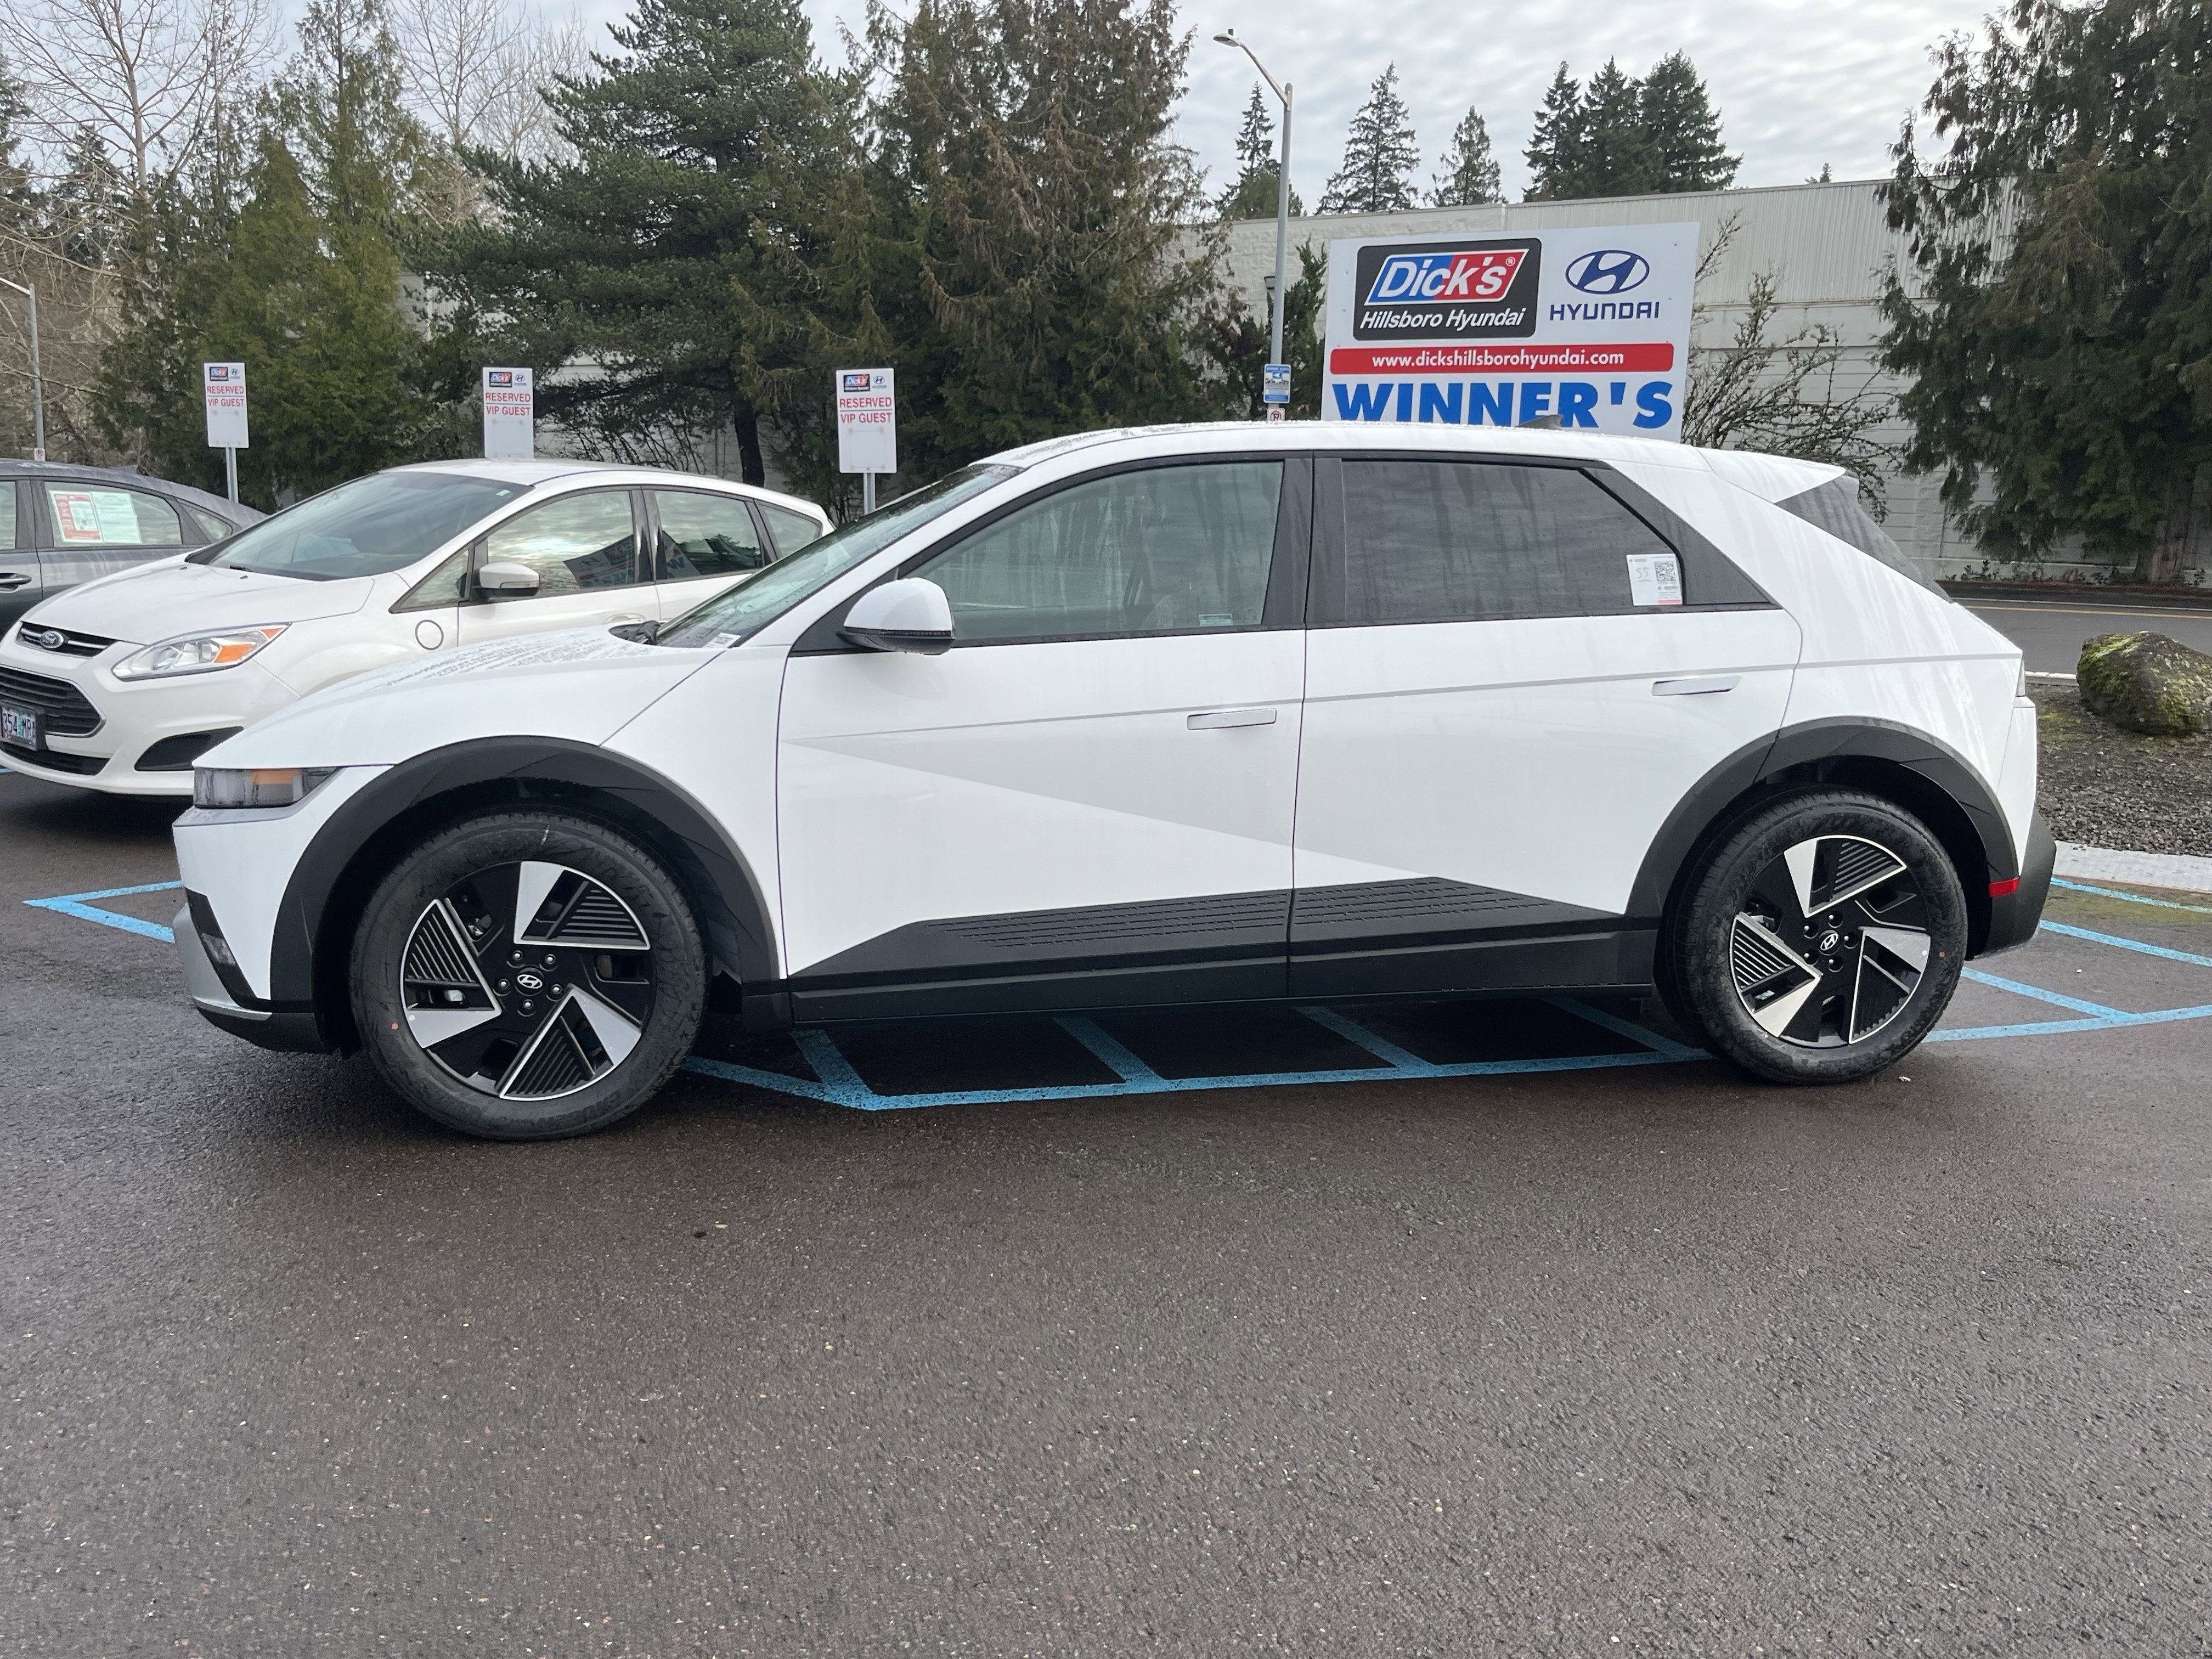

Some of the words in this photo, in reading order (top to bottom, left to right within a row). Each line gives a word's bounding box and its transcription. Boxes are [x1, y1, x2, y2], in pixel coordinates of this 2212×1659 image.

[1378, 257, 1507, 297] Dick's
[1550, 301, 1660, 321] HYUNDAI
[1359, 310, 1443, 329] Hillsboro
[1445, 307, 1527, 331] Hyundai
[1372, 348, 1624, 370] www.dickshillsborohyundai.com
[207, 386, 244, 394] RESERVED
[486, 392, 531, 402] RESERVED
[839, 397, 892, 408] RESERVED
[208, 399, 219, 407] VIP
[221, 399, 244, 407] GUEST
[1332, 381, 1674, 429] WINNER'S
[486, 406, 499, 415] VIP
[501, 407, 531, 416] GUEST
[840, 414, 856, 423] VIP
[859, 413, 892, 423] GUEST
